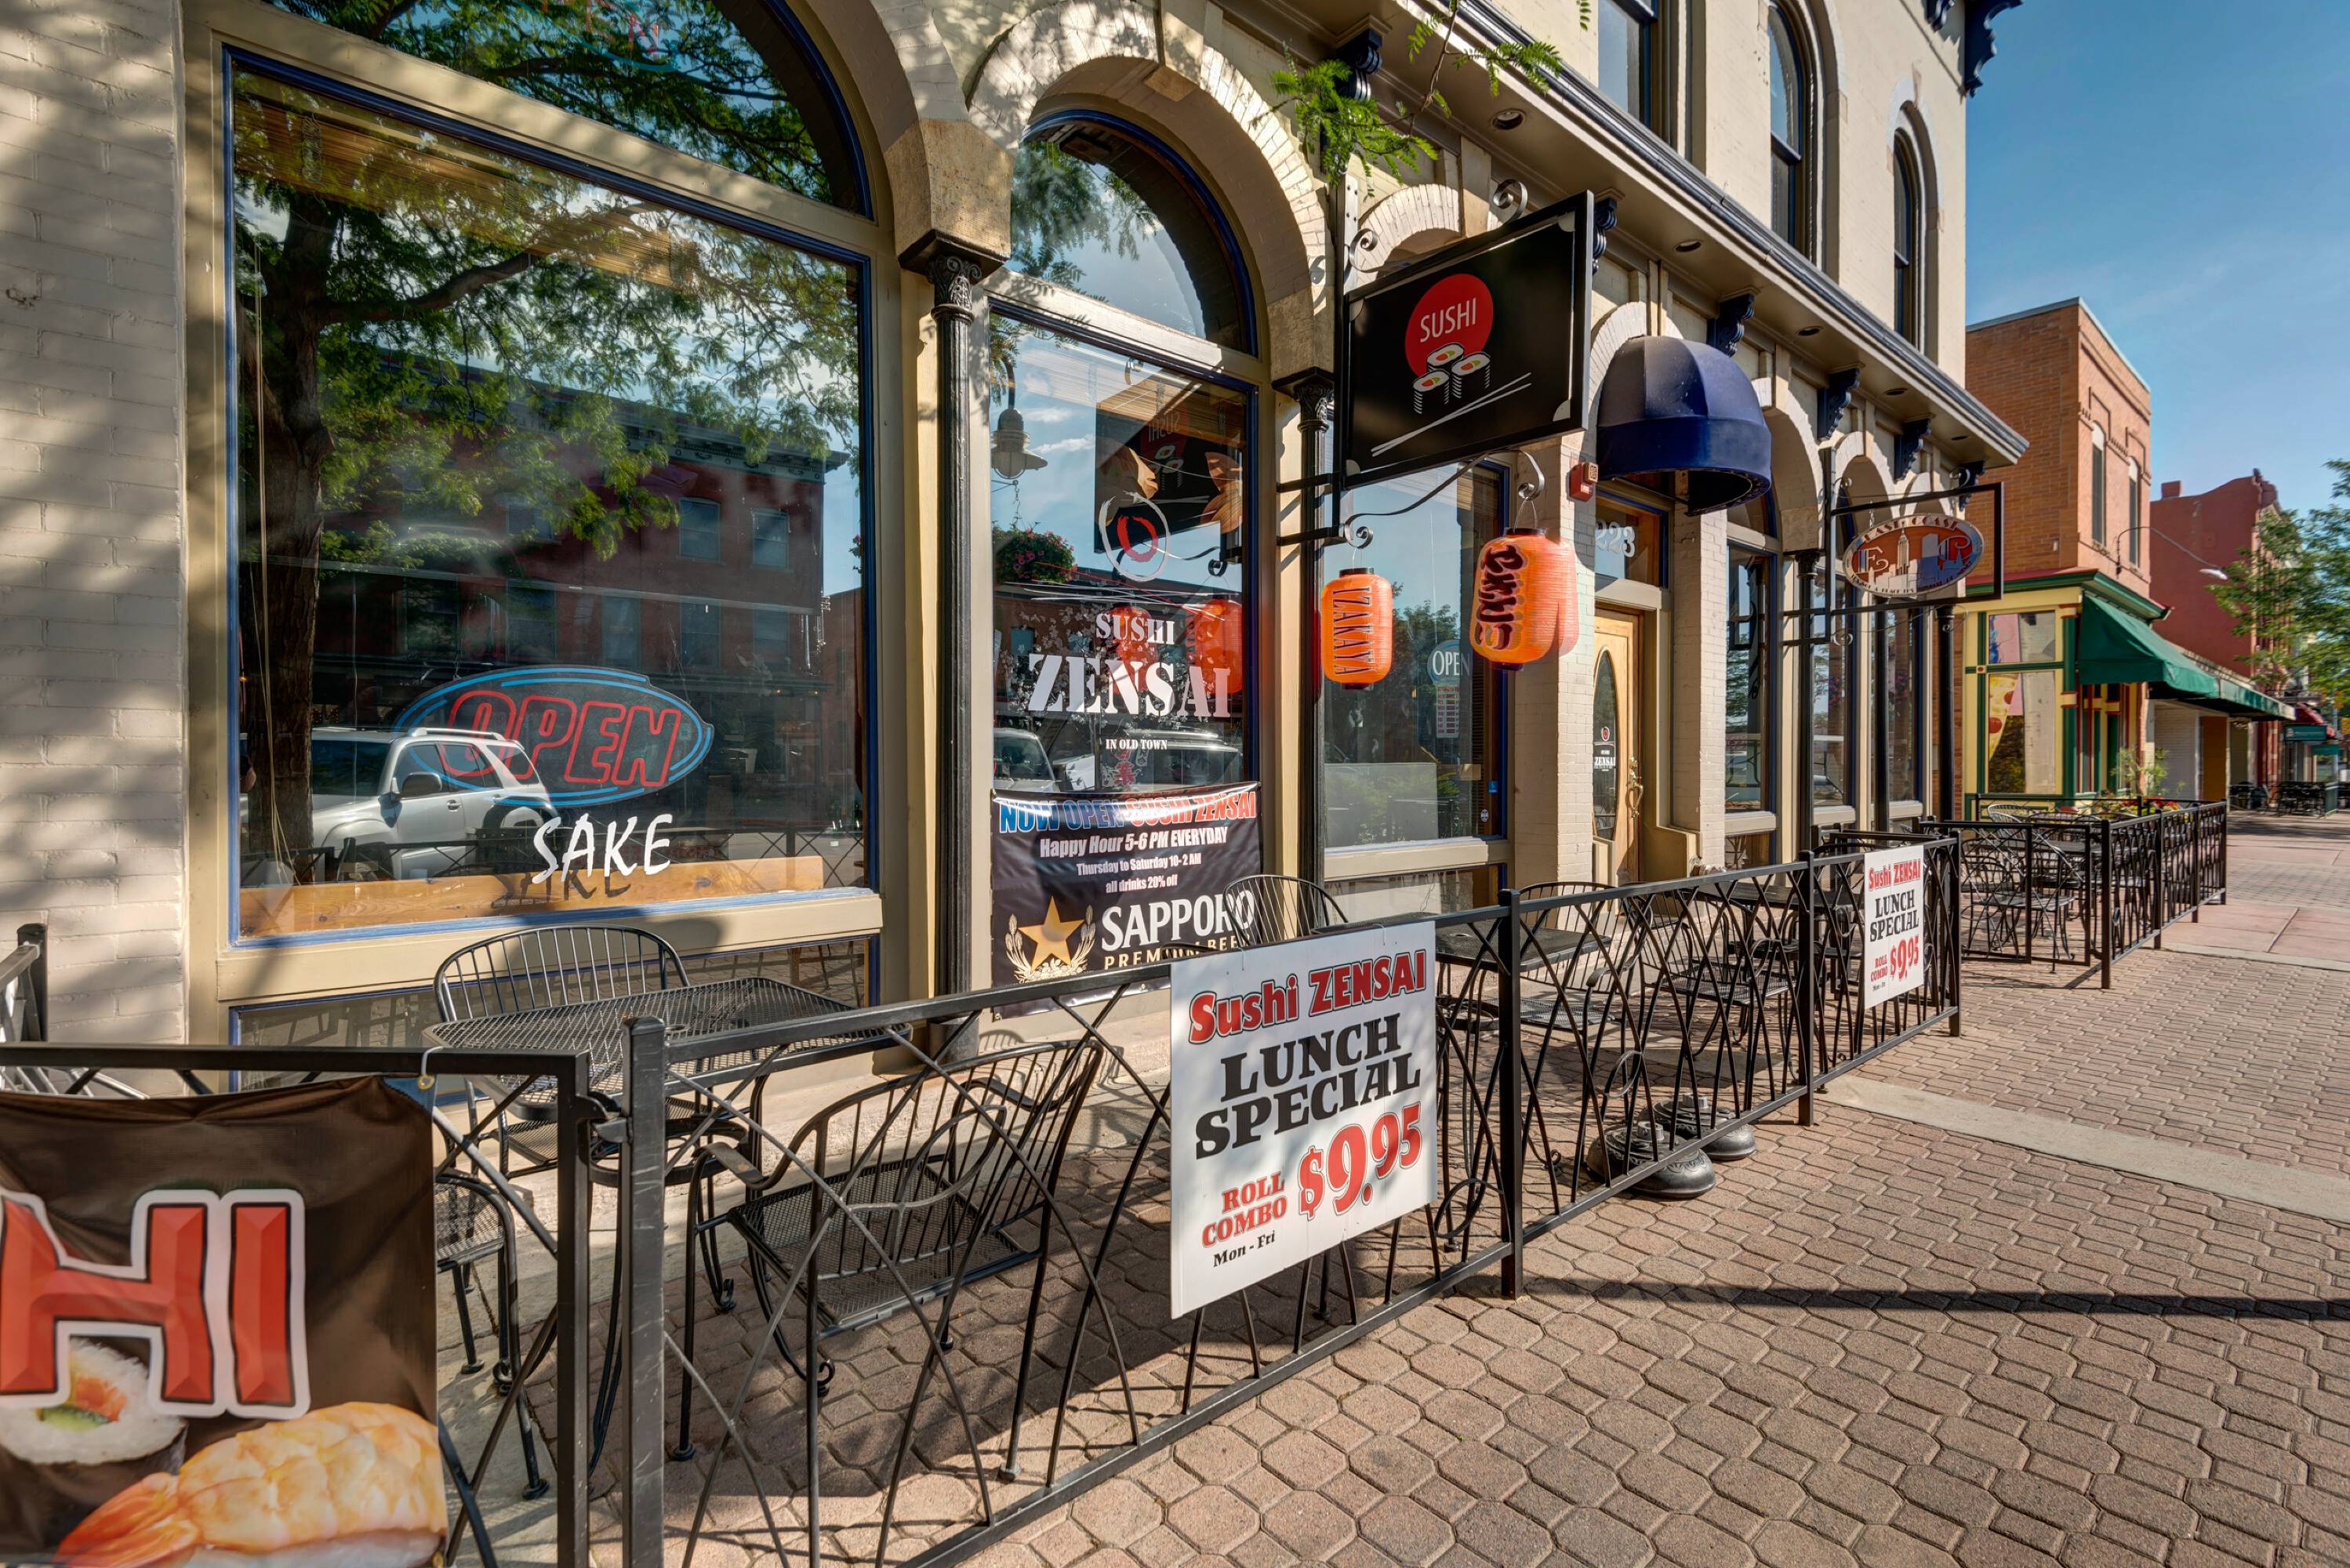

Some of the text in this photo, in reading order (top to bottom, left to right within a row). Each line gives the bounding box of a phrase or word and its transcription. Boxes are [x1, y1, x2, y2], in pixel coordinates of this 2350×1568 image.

[1419, 297, 1477, 343] SUSHI
[1095, 612, 1175, 645] SUSHI
[1333, 586, 1374, 675] IZAKAYA
[1028, 653, 1231, 718] ZENSAI
[1432, 650, 1471, 676] OPEN
[439, 689, 683, 787] OPEN
[1106, 739, 1168, 750] IN OLD TOWN
[999, 791, 1256, 833] NOW OPEN SUSHI ZENSAI
[532, 812, 673, 884] SAKE
[1040, 826, 1229, 858] Happy Hour 5-6 PM EVERYDAY
[1077, 862, 1119, 876] Thursday
[1120, 860, 1129, 871] to
[1130, 856, 1168, 871] Saturday
[1182, 854, 1188, 866] 2
[1189, 853, 1201, 866] AM
[1106, 874, 1178, 894] all drinks 20% off
[1869, 858, 1921, 891] Sushi ZENSAI
[1101, 889, 1255, 952] SAPPORO
[1870, 909, 1919, 942] SPECIAL
[1875, 889, 1915, 919] LUNCH
[1875, 935, 1920, 981] ROLL $9.95
[1189, 949, 1427, 1044] Sushi ZENSAI
[1220, 1012, 1402, 1102] LUNCH
[1195, 1052, 1421, 1160] SPECIAL
[1222, 1102, 1422, 1221] ROLL $9.95
[1202, 1196, 1288, 1248] COMBO
[1213, 1246, 1246, 1268] Mon
[1257, 1229, 1276, 1249] Fri
